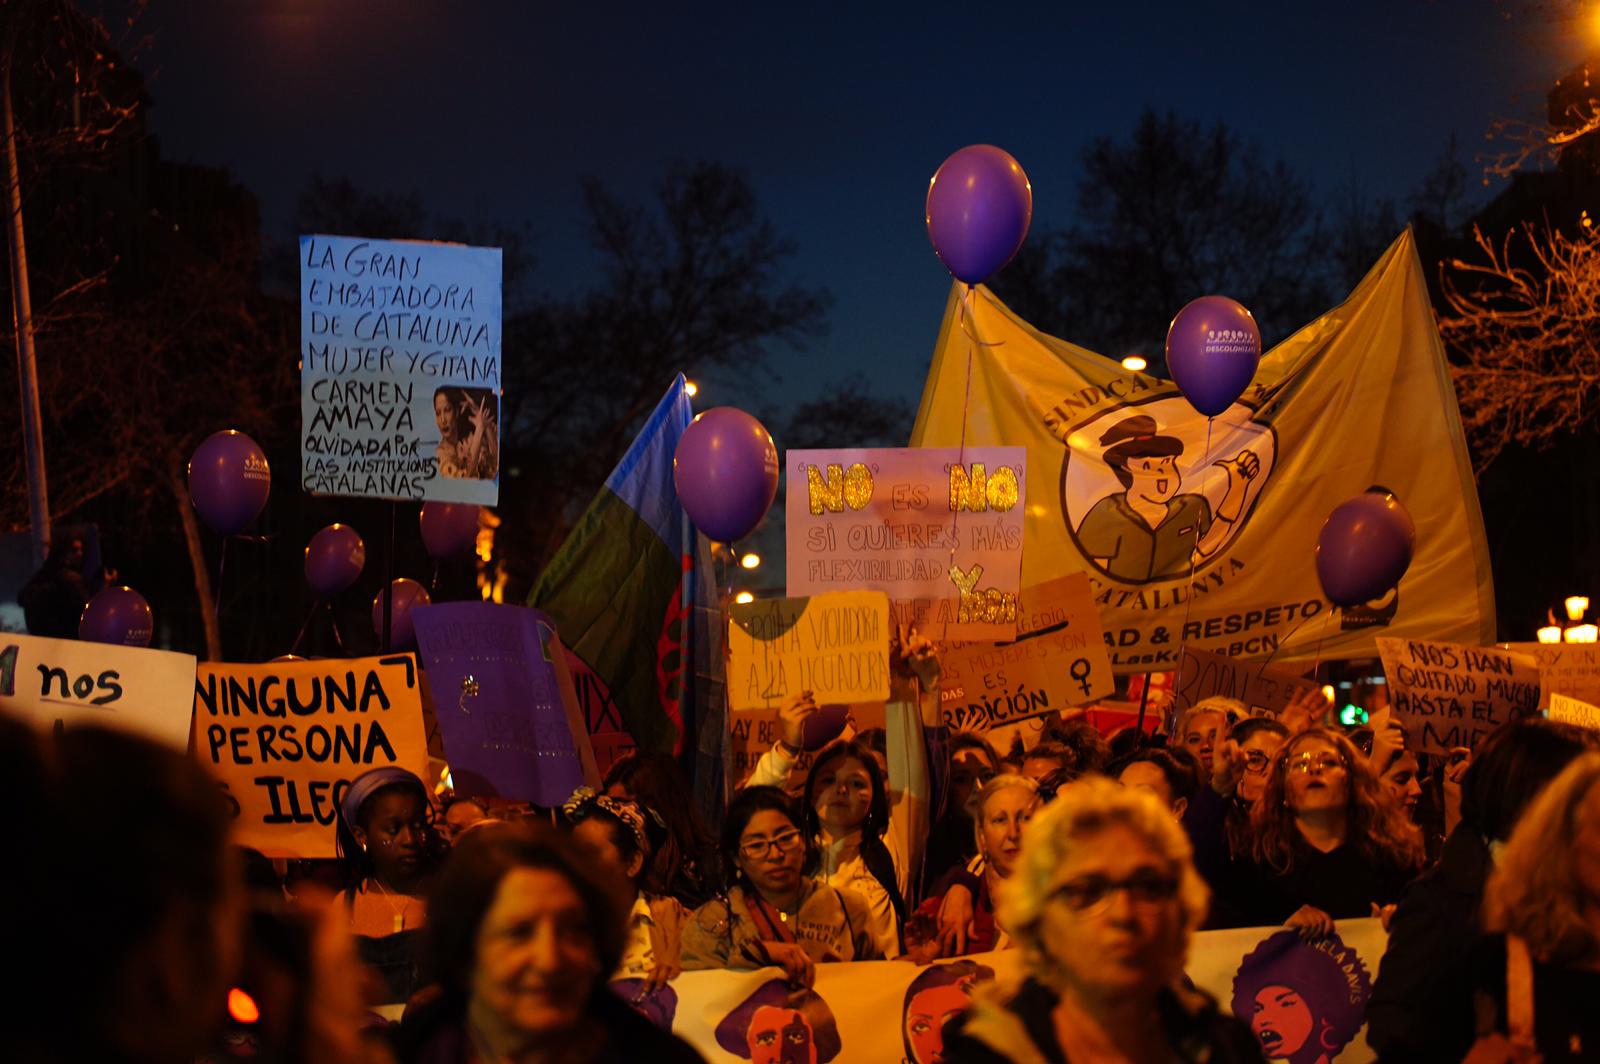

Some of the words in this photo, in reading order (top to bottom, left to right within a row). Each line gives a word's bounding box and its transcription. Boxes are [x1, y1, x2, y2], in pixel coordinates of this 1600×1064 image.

[307, 239, 335, 272] LA
[344, 243, 421, 281] GRAN
[309, 279, 475, 313] EMBAJADORA
[311, 311, 343, 337] DE
[354, 311, 490, 350] CATALUÑA
[309, 342, 395, 376] MUJER
[420, 350, 498, 384] GITANA
[311, 379, 413, 406] CARMEN
[310, 404, 413, 432] AMAYA
[306, 457, 339, 475] LAS
[304, 474, 426, 497] CATALANAS
[892, 483, 930, 511] ES
[972, 516, 1020, 552] MÁS
[808, 559, 943, 582] FLEXIBILIDAD
[1150, 626, 1172, 646] &
[1182, 600, 1323, 641] RESPETO
[1408, 641, 1460, 669] NOS
[1464, 650, 1514, 676] HAN
[37, 663, 123, 705] nos
[194, 669, 391, 718] NINGUNA
[984, 670, 1008, 690] ES
[1397, 664, 1477, 696] QUITADO
[1395, 690, 1464, 719] HASTA
[1471, 701, 1501, 725] EL
[207, 720, 397, 764] PERSONA
